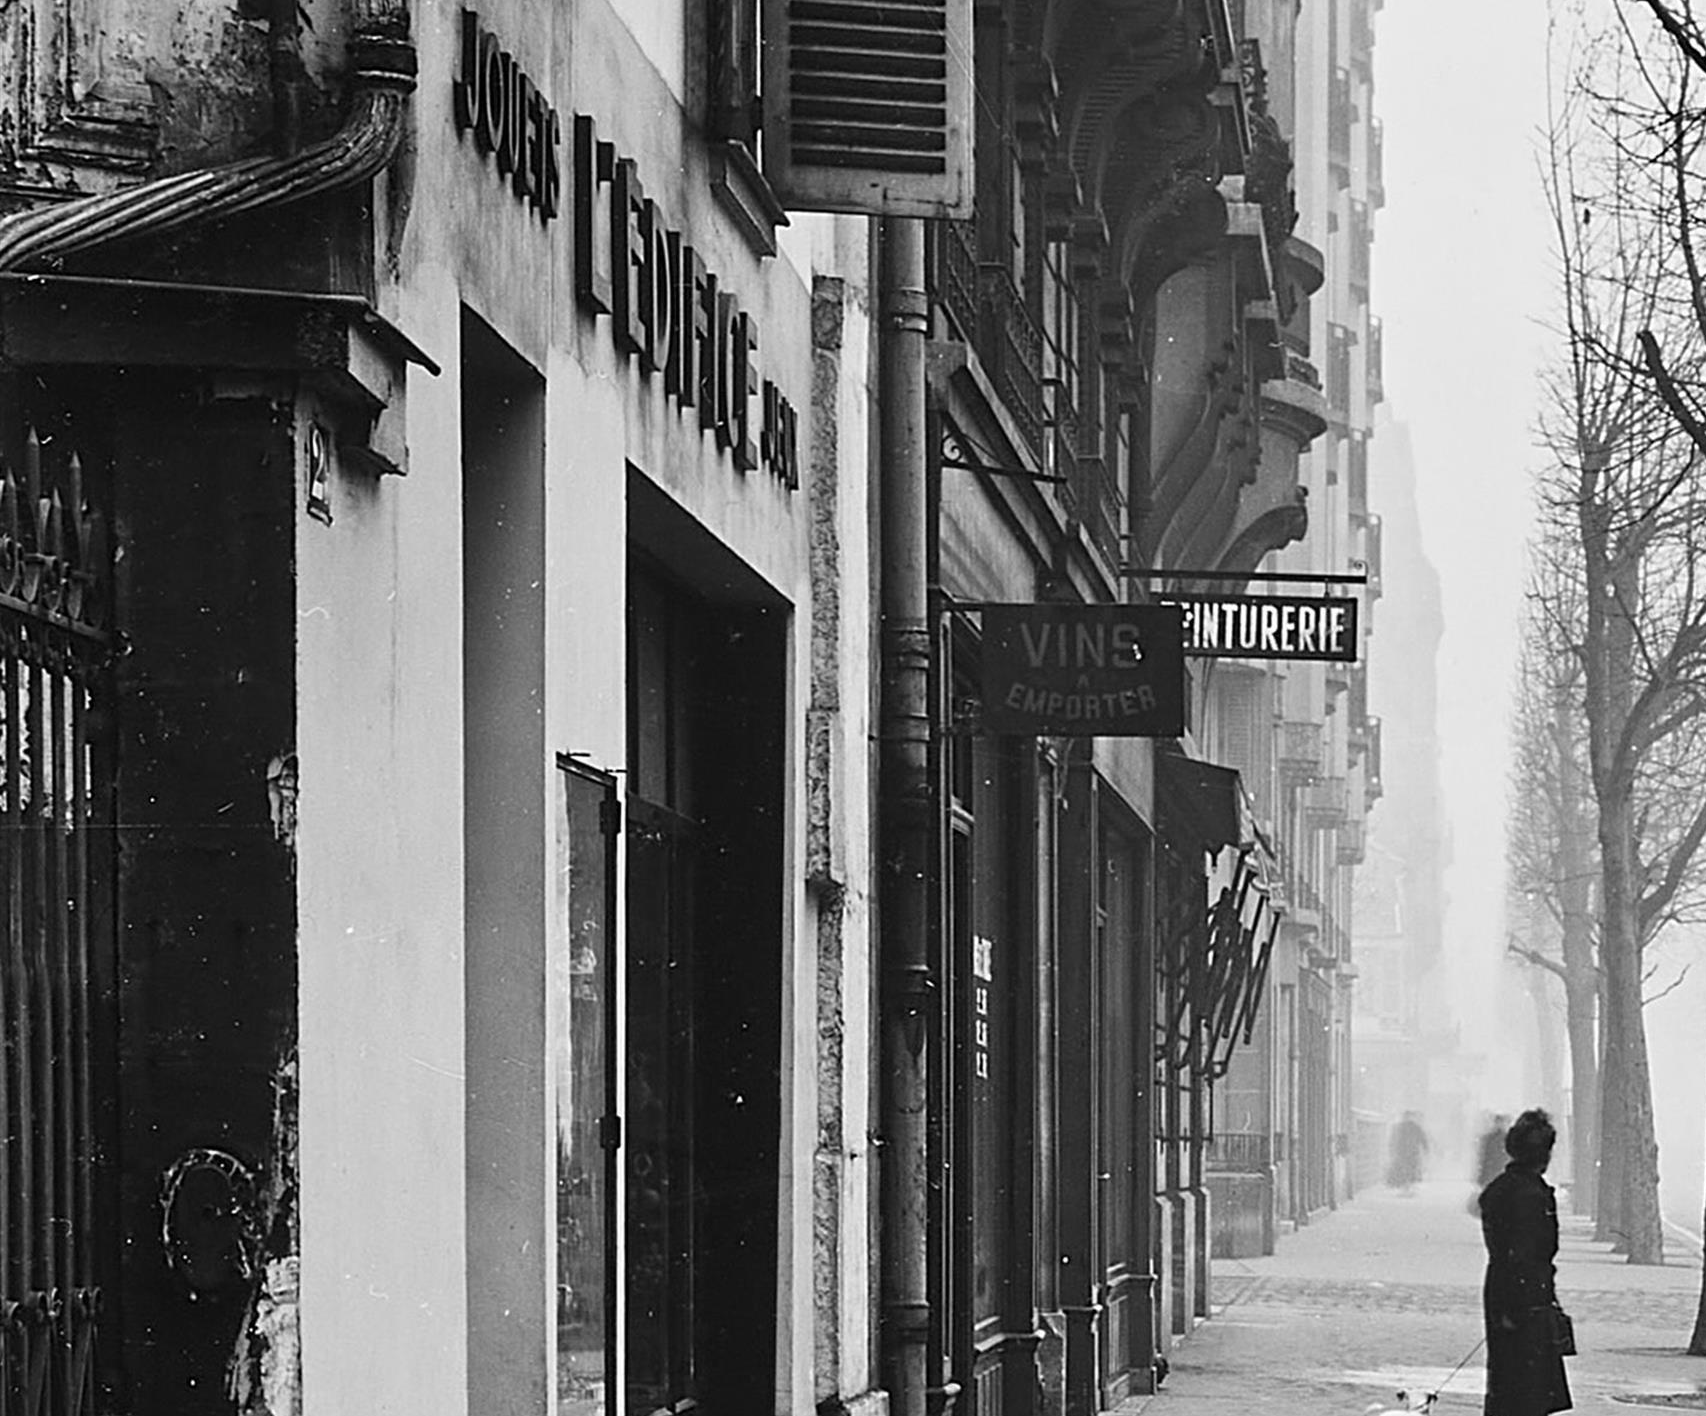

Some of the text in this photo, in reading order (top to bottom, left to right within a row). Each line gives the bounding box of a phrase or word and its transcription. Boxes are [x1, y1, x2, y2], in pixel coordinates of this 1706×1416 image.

[452, 7, 560, 218] JOUETS
[1020, 622, 1141, 669] VINS
[1162, 601, 1346, 653] EINTURERIE
[1006, 682, 1157, 721] EMPORTER
